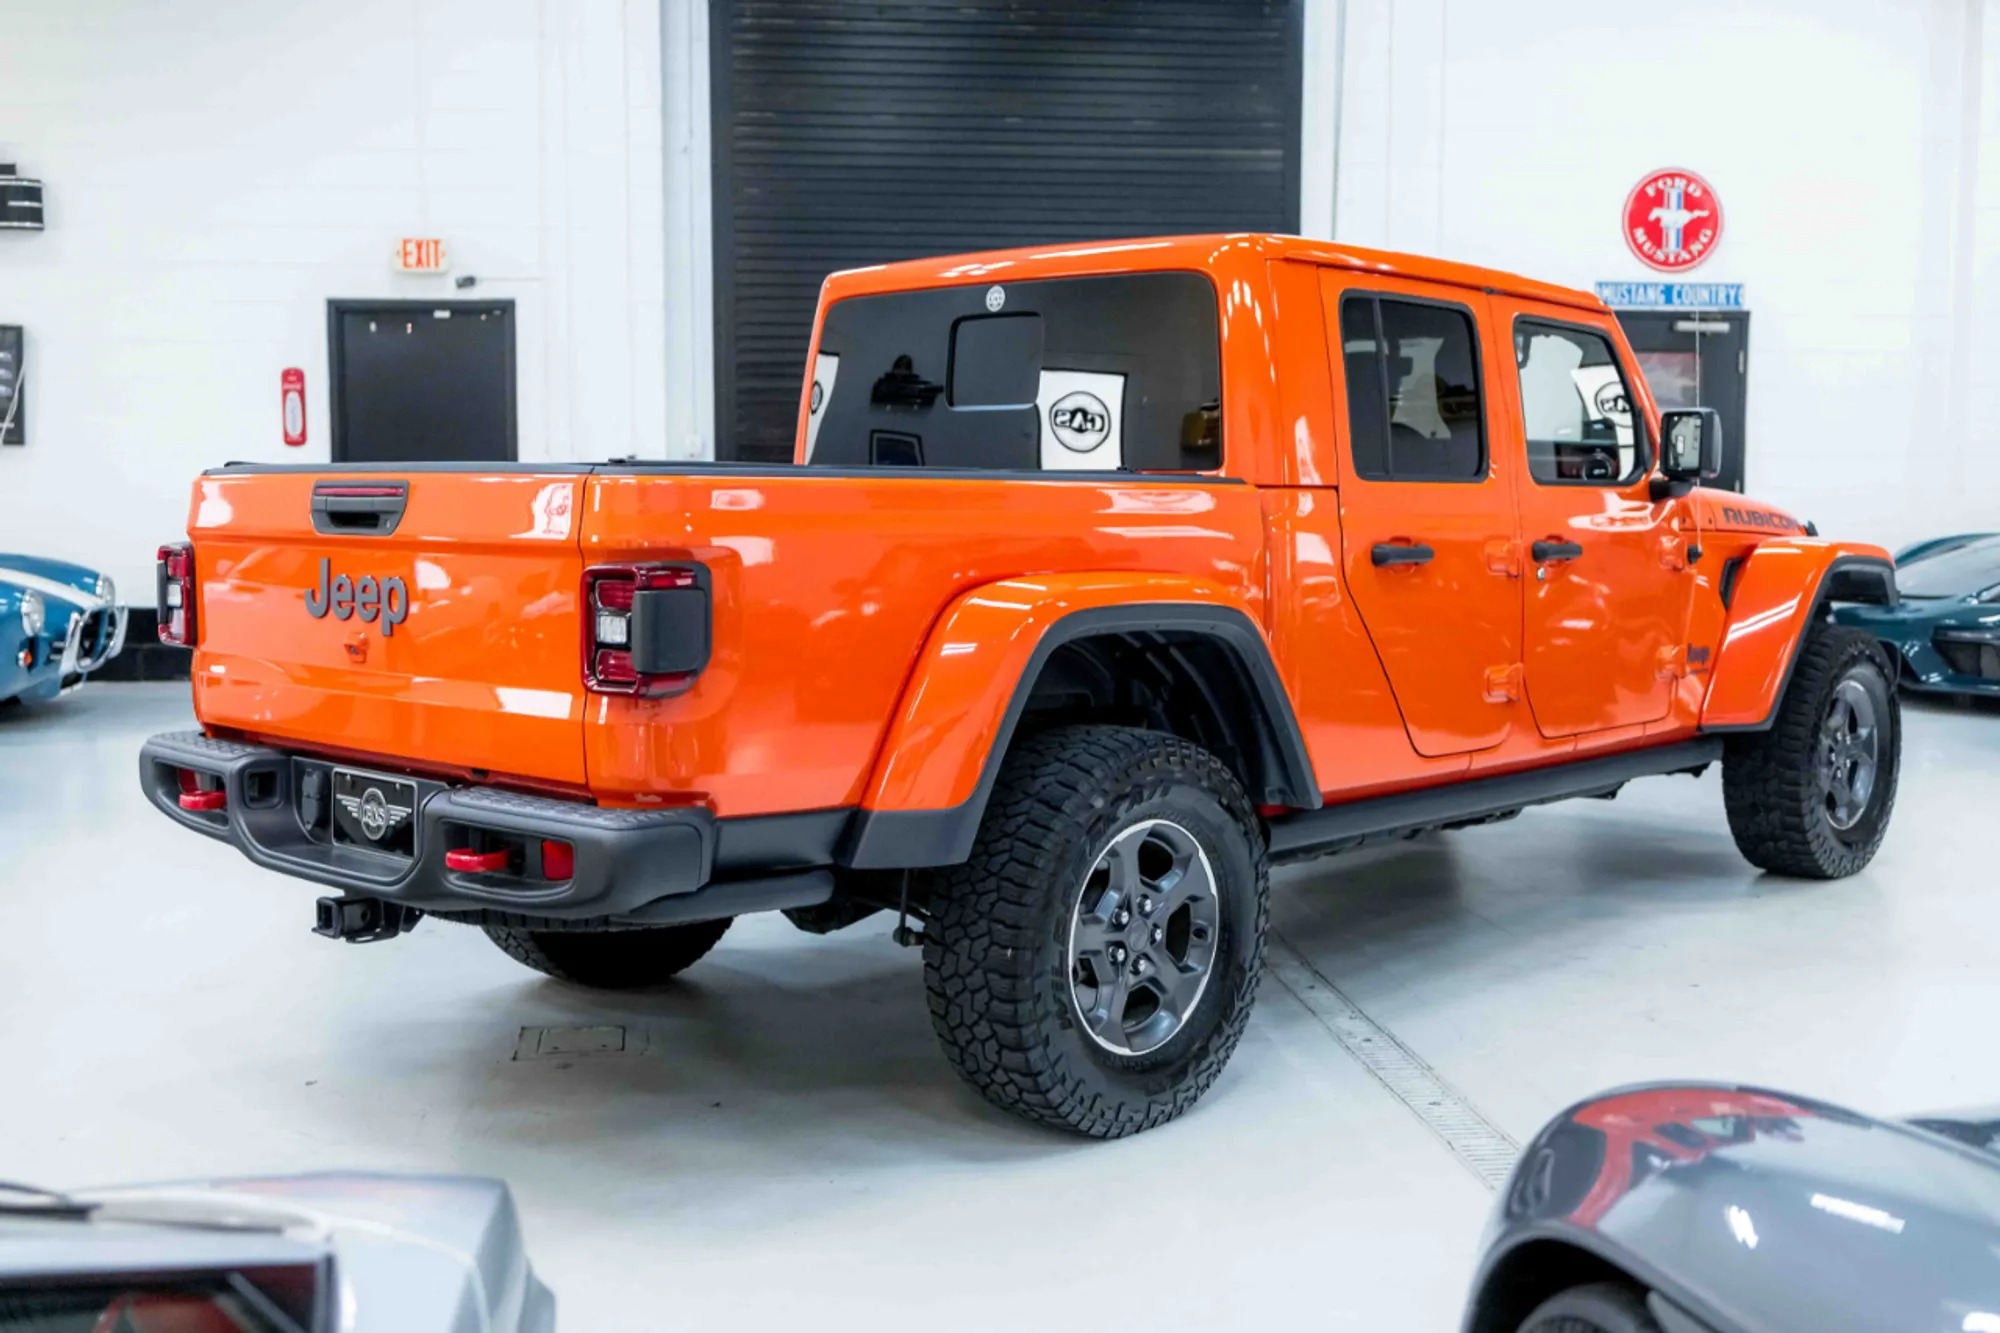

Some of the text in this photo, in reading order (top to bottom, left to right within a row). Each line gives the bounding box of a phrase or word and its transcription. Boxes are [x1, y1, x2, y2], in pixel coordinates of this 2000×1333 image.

[1644, 176, 1703, 198] FORD
[402, 238, 441, 269] EXIT
[1632, 227, 1713, 264] MUSTANG
[1599, 283, 1740, 306] MUSTANG COUNTRY
[1722, 507, 1798, 530] RUBICON
[304, 557, 409, 637] Jeep
